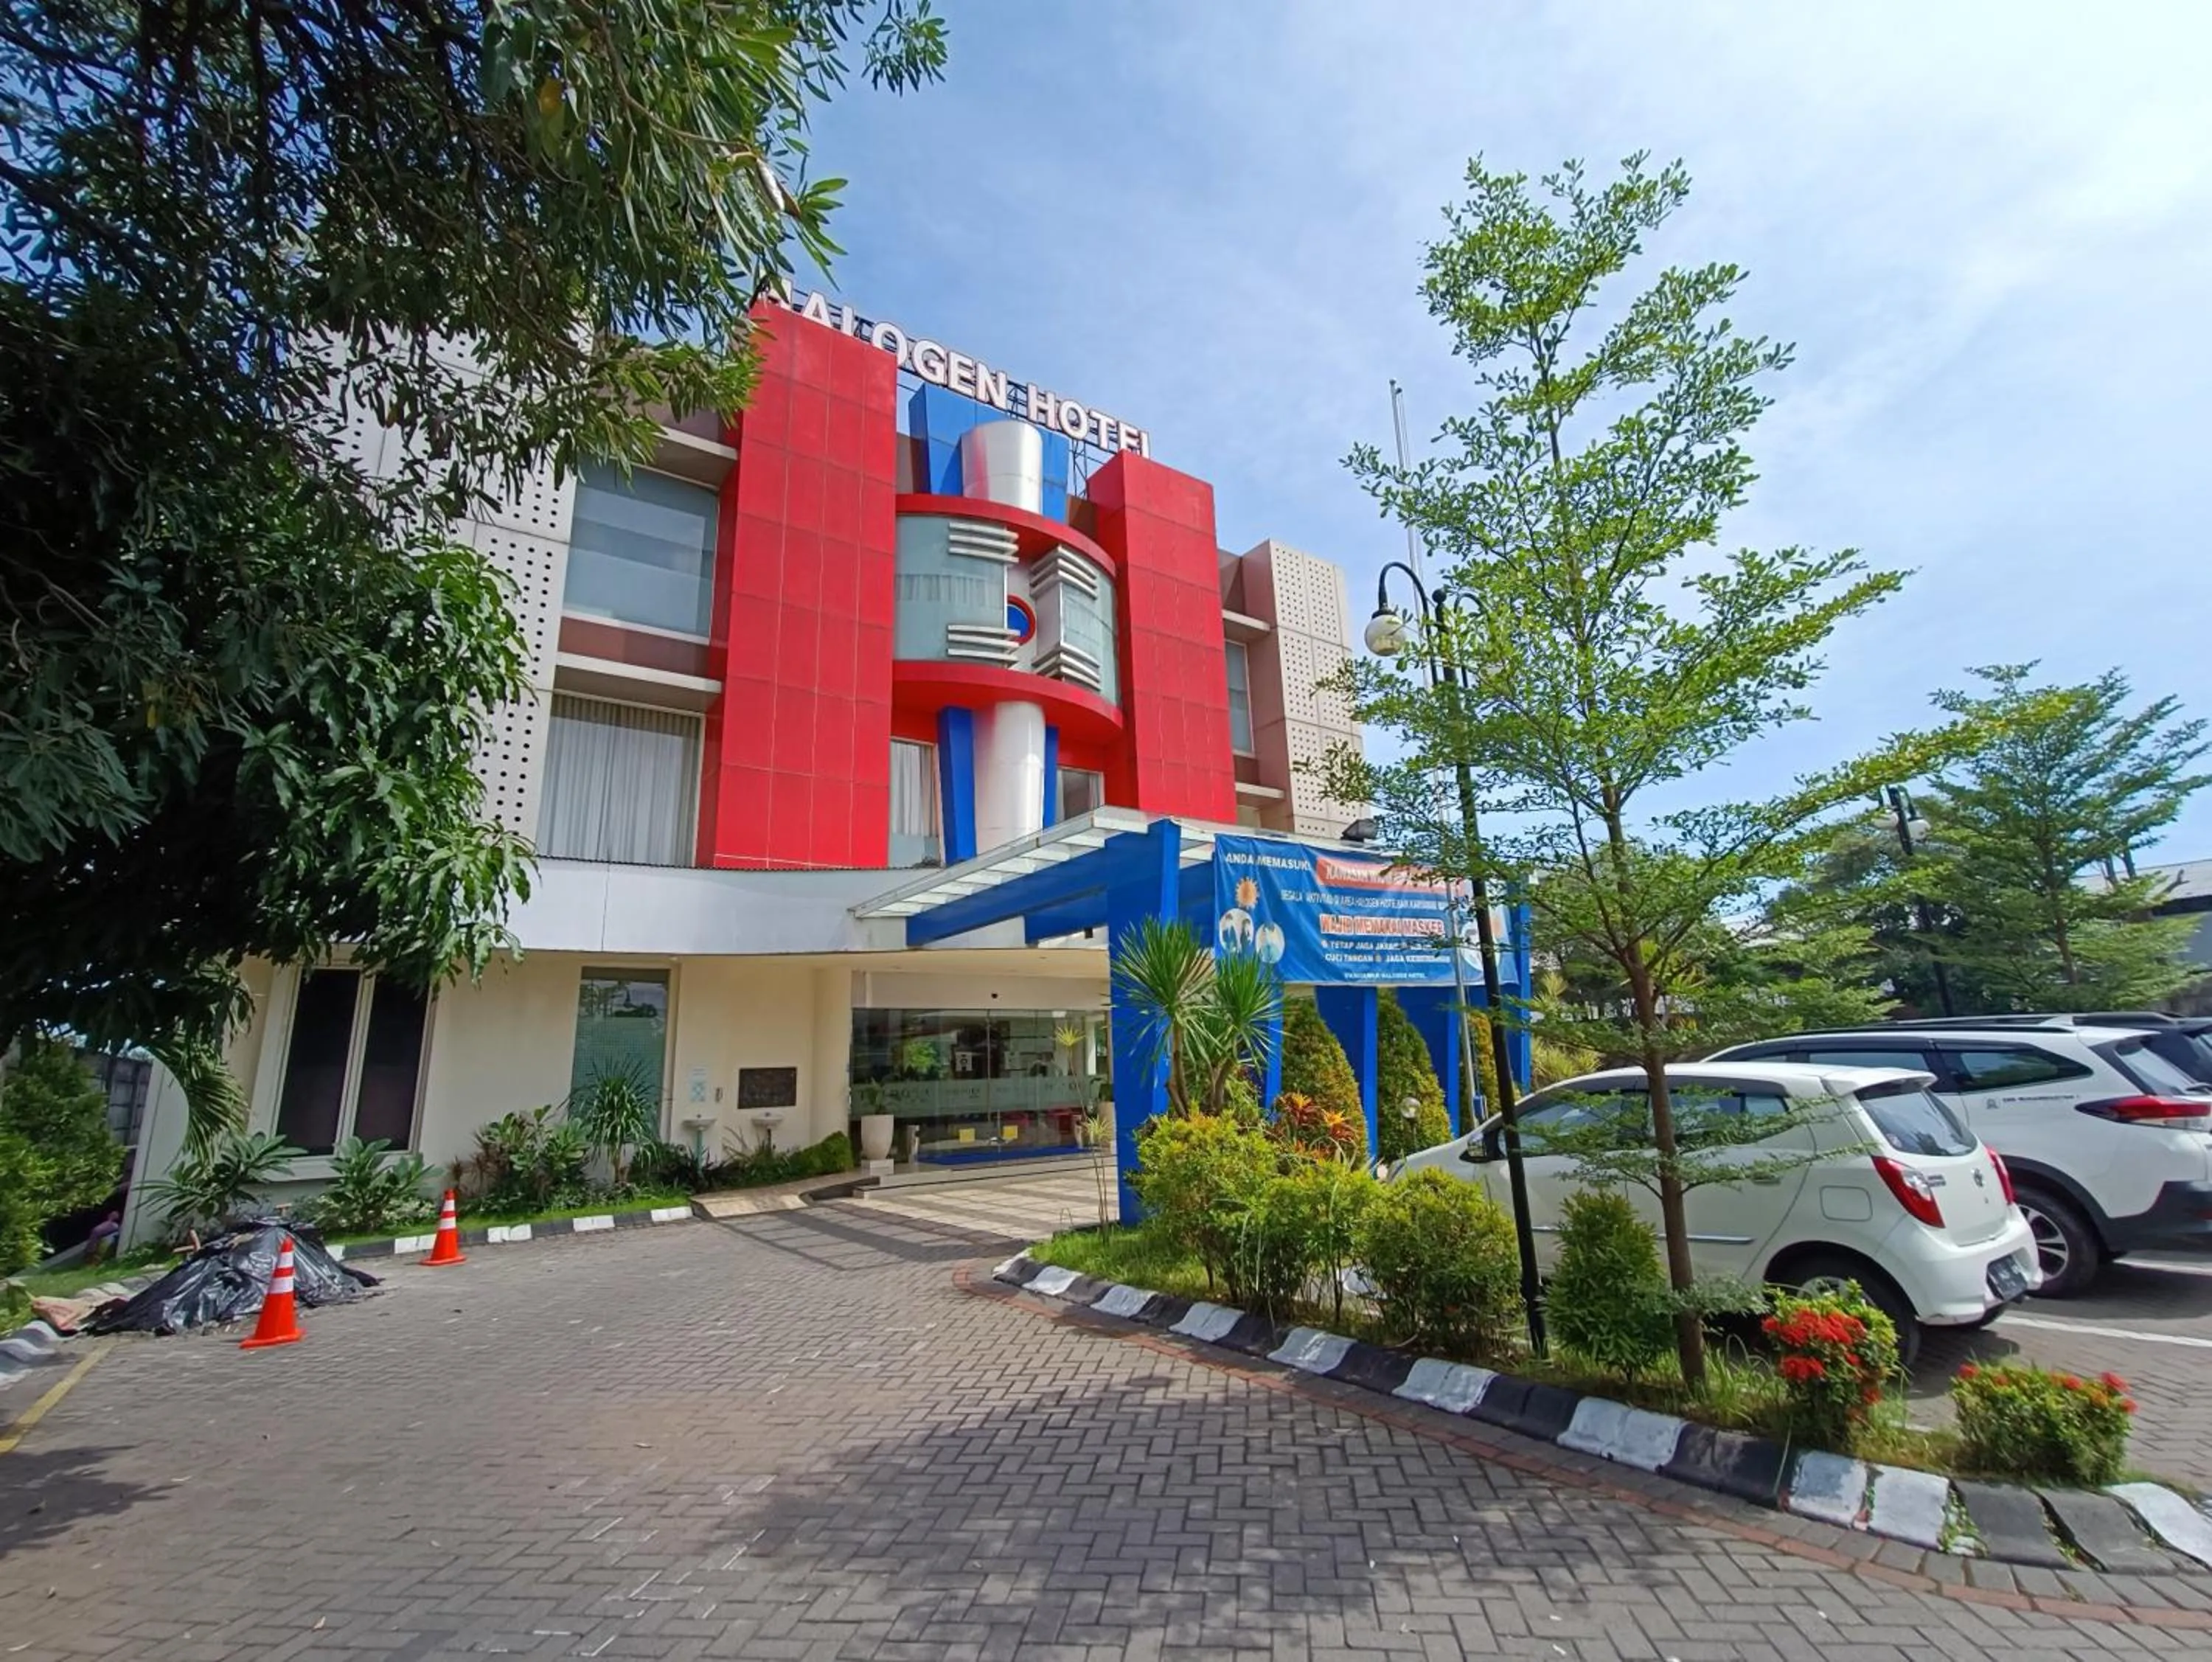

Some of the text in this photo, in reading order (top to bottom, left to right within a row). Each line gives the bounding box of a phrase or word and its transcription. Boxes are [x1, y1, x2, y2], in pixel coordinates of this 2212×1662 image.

[1026, 381, 1150, 459] HOTEL
[1225, 852, 1254, 865] ANDA
[1256, 855, 1312, 871] MEMASUKI
[1354, 916, 1402, 936] MEMAKAI
[1402, 918, 1445, 937] MASKER
[1325, 953, 1343, 962] CUCI
